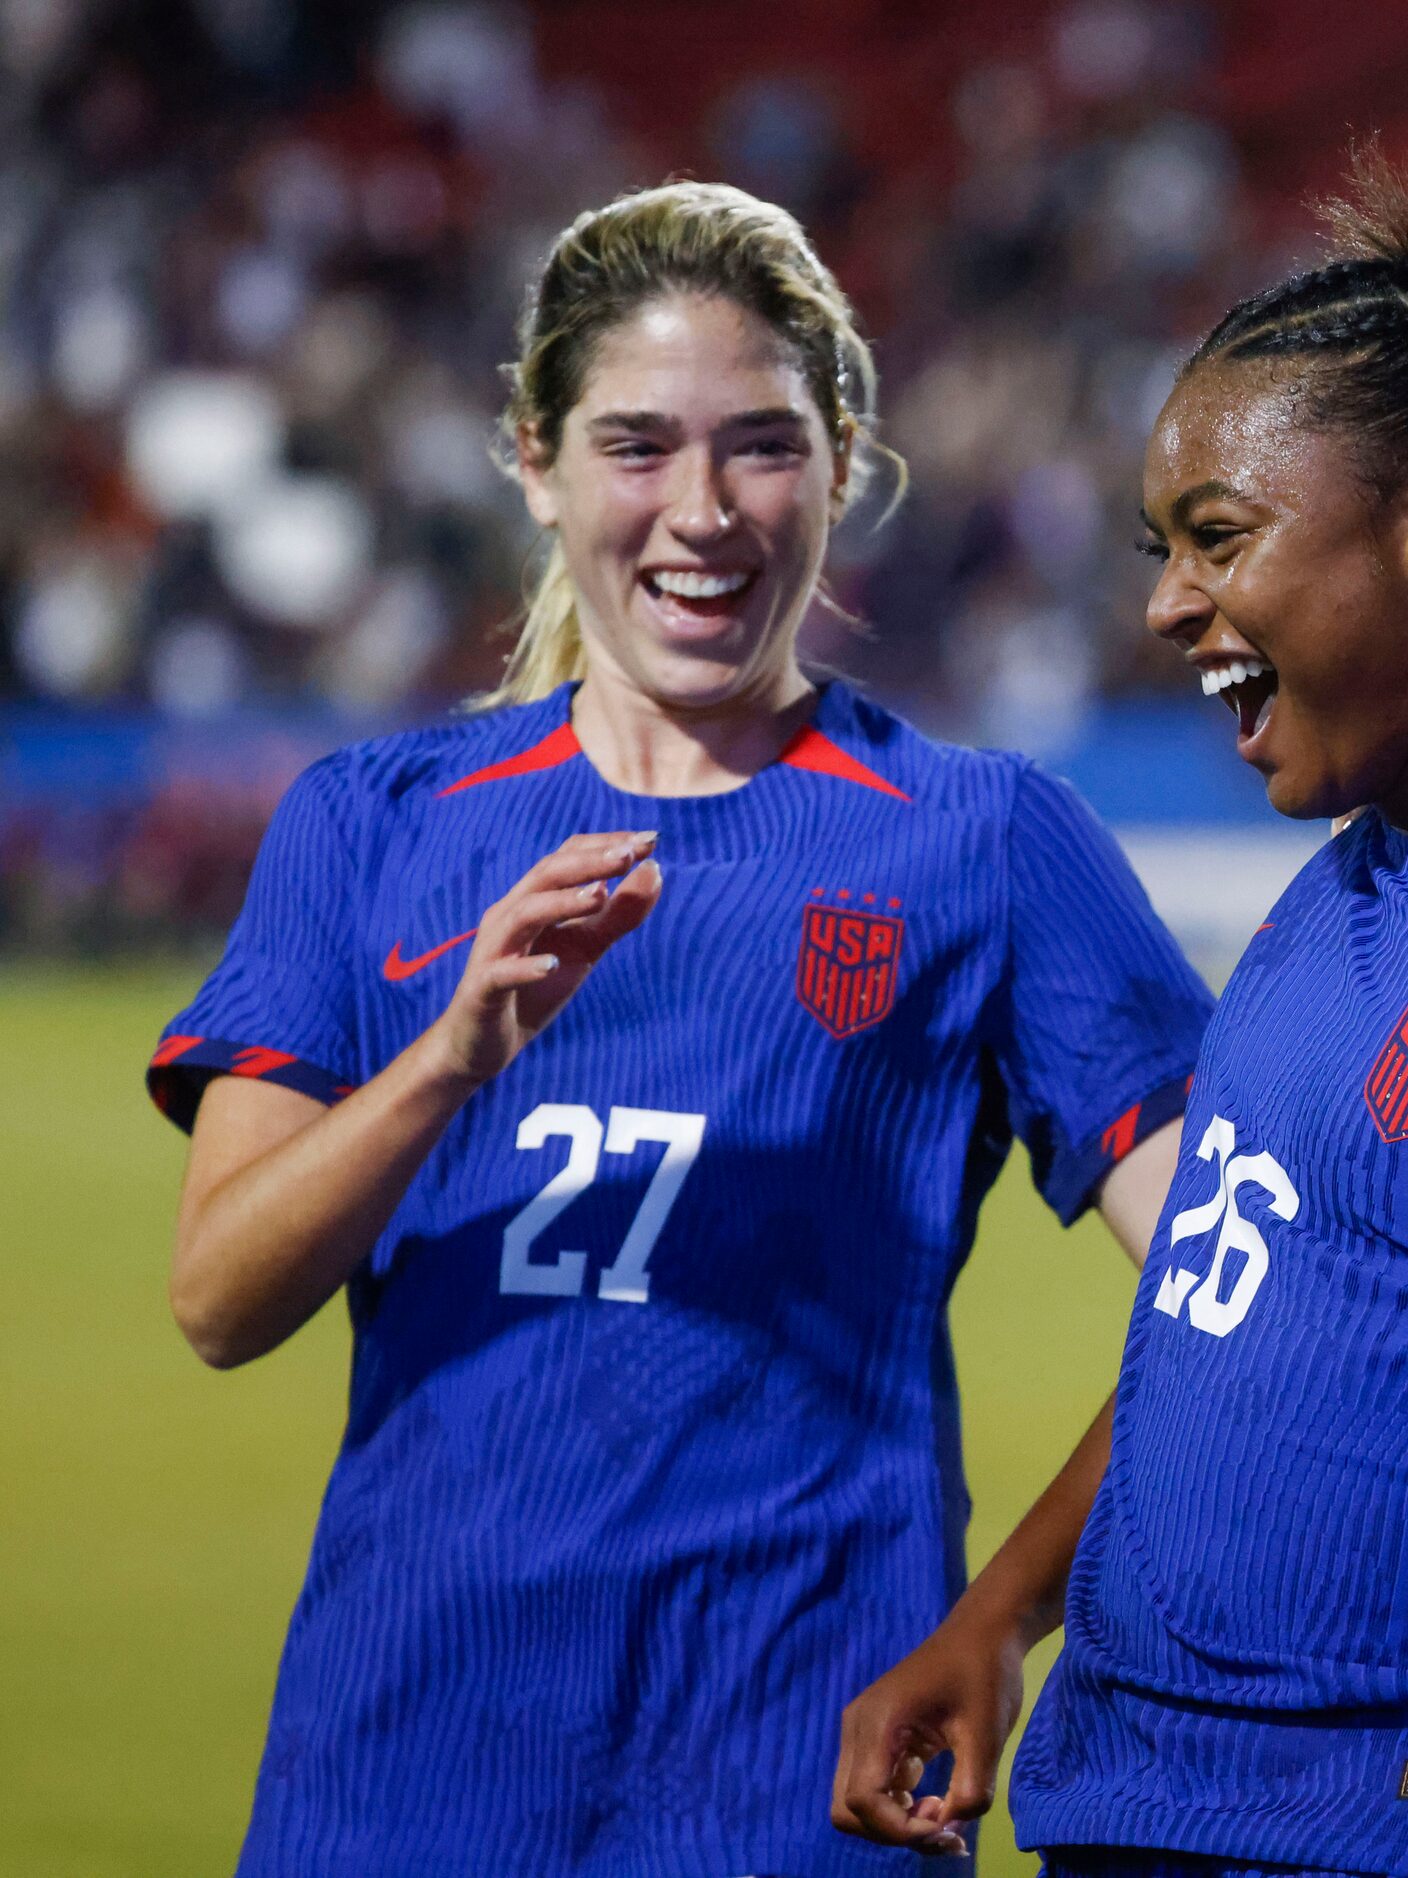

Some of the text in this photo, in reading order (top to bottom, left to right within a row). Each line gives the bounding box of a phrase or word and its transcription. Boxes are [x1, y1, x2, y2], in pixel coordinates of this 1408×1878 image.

[809, 912, 894, 966] USA
[499, 1103, 706, 1304] 27
[1153, 1113, 1300, 1338] 26
